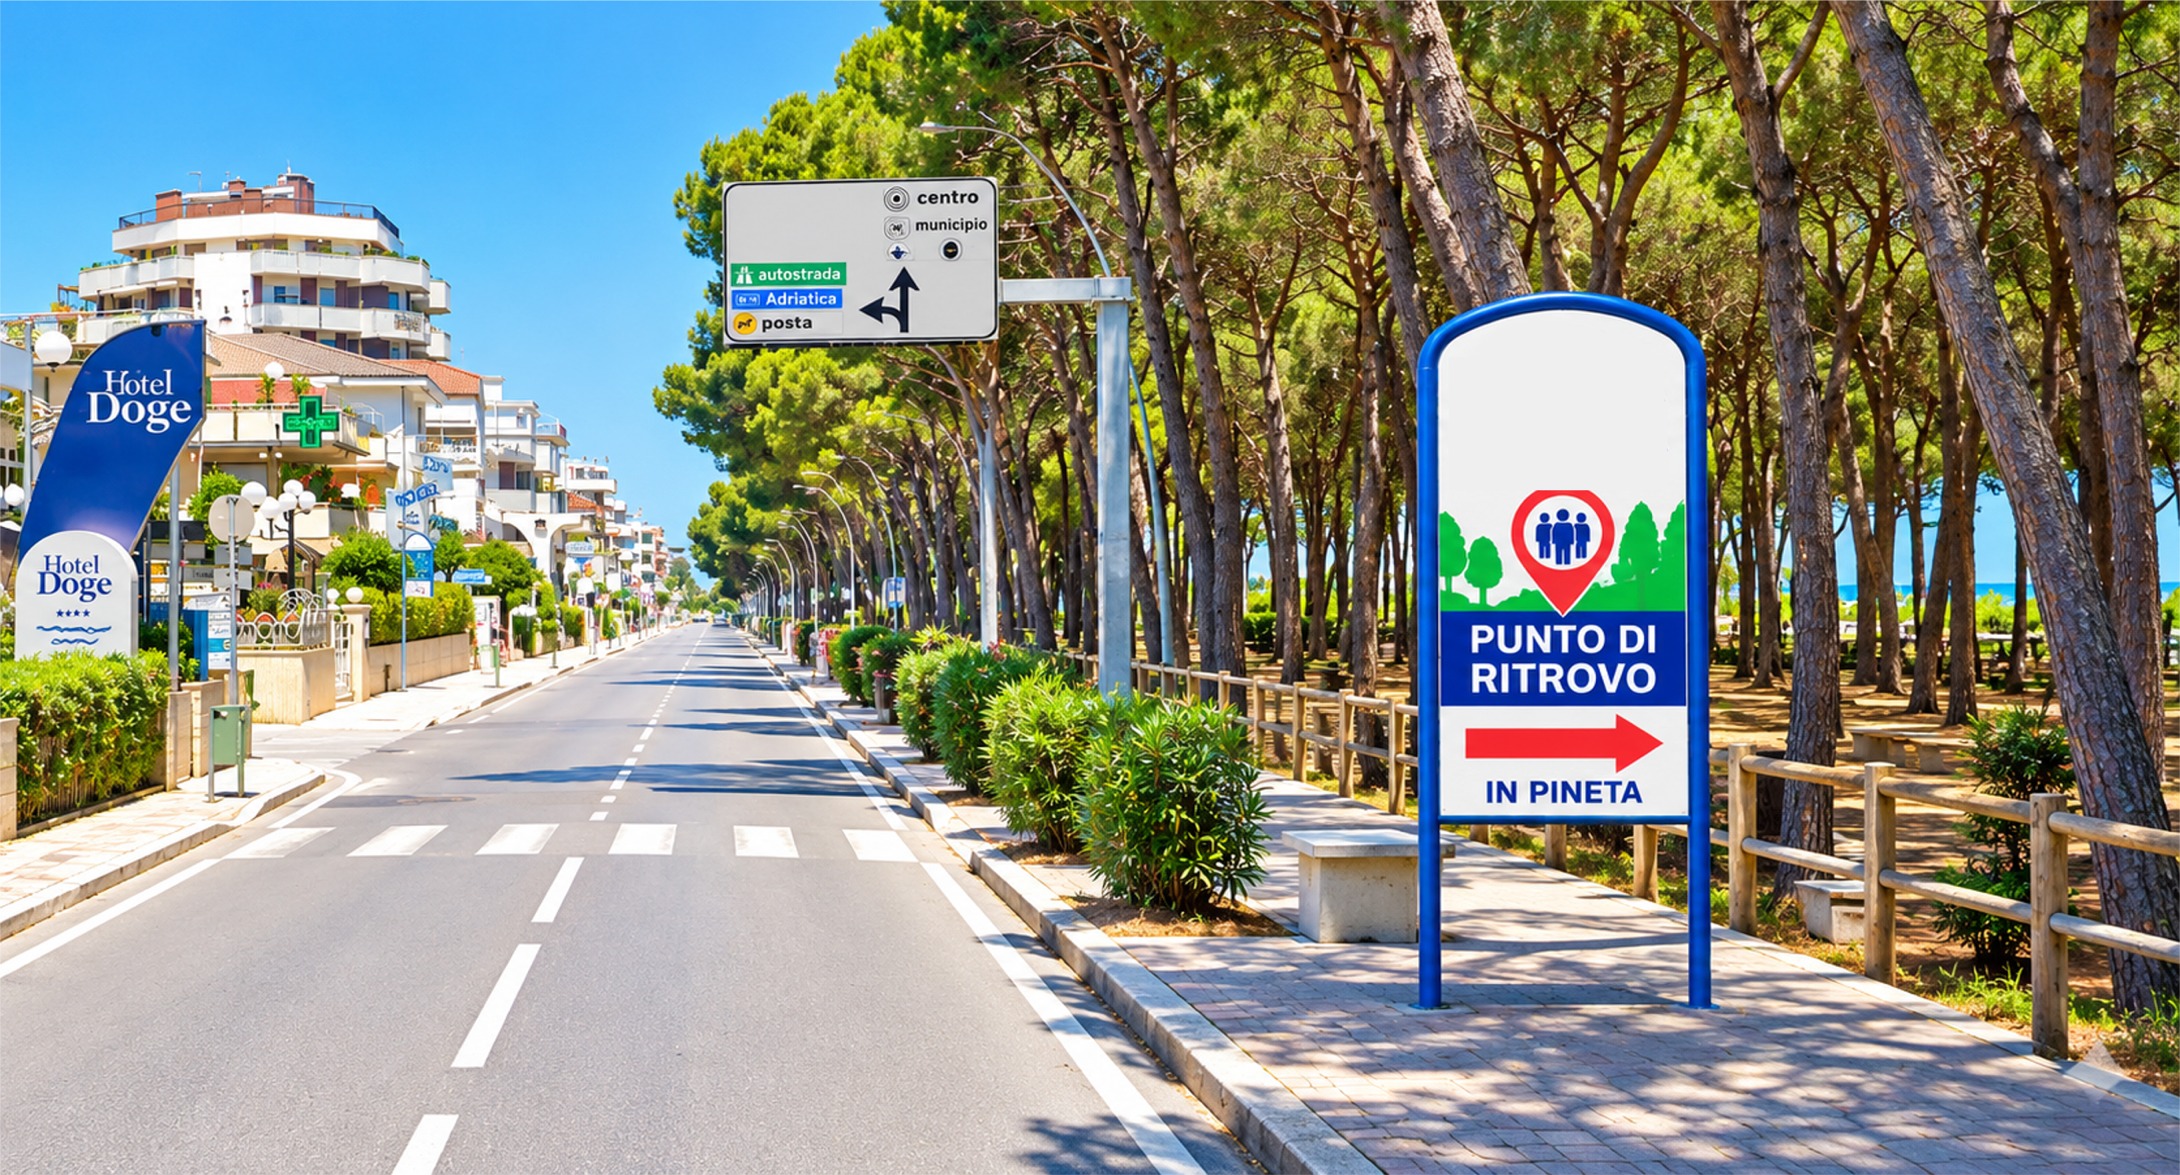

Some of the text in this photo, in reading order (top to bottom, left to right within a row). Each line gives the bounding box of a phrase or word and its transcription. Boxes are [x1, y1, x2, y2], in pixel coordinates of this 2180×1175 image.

[917, 190, 979, 205] centro
[915, 217, 988, 234] municipio
[758, 266, 841, 282] autostrada
[766, 291, 837, 306] Adriatica
[762, 317, 813, 333] posta
[103, 369, 174, 396] Hotel
[86, 391, 192, 434] Doge
[44, 555, 99, 574] Hotel
[36, 571, 113, 603] Doge
[1471, 624, 1656, 654] PUNTO DI
[1471, 662, 1656, 694] RITROVO
[1486, 780, 1643, 804] IN PINETA
